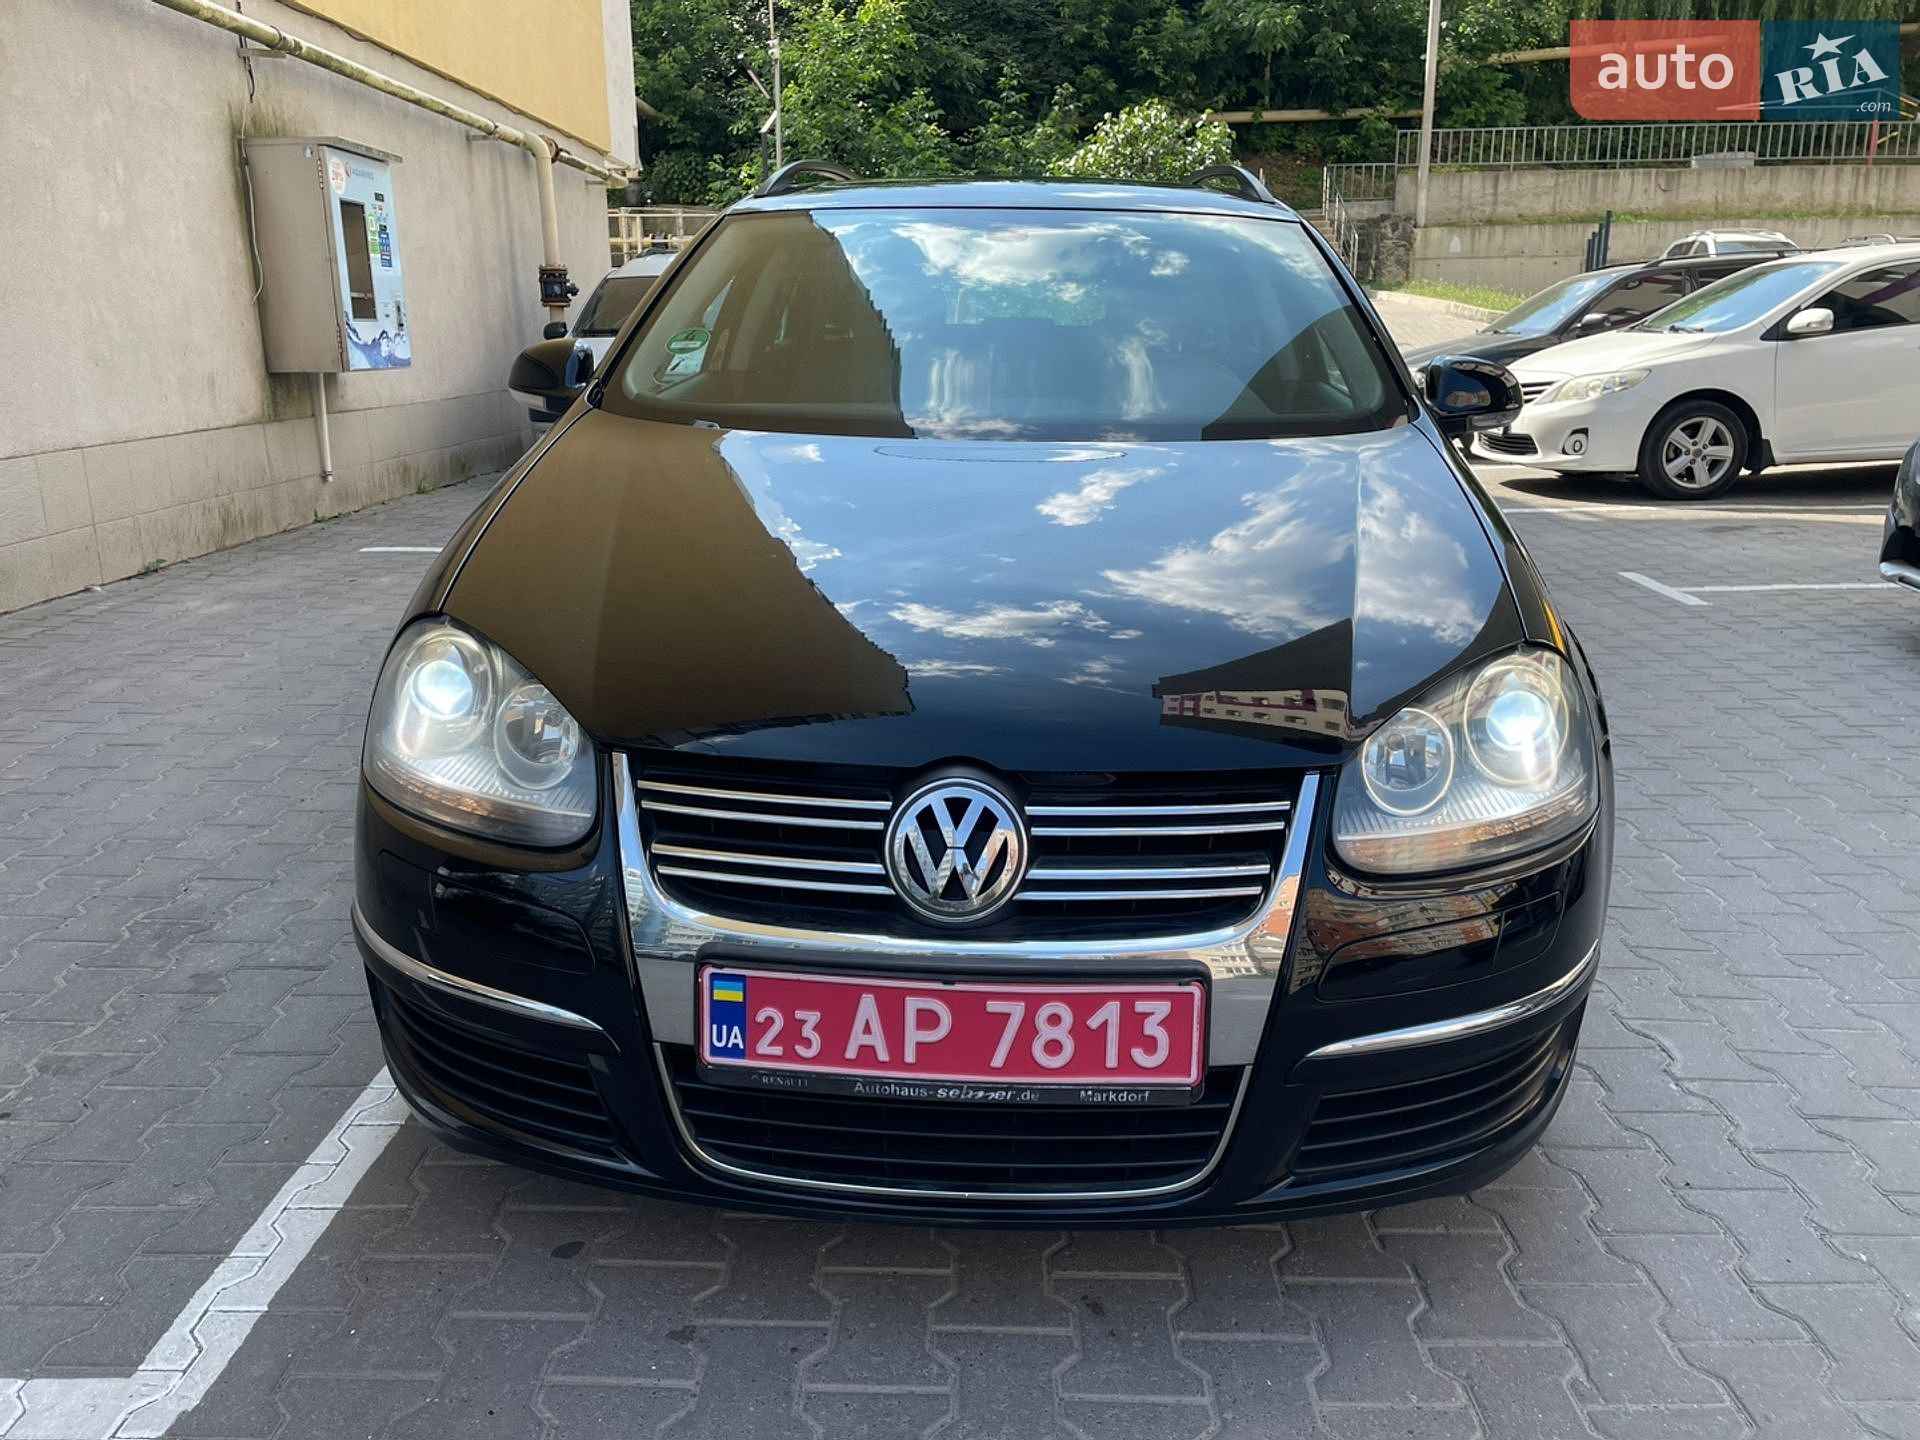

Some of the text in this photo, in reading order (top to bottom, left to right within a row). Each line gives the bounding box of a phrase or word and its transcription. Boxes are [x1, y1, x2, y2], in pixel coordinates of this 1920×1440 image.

[711, 1024, 744, 1049] UA
[754, 993, 1172, 1069] 23 AP 7813
[1079, 1090, 1150, 1102] Markdorf
